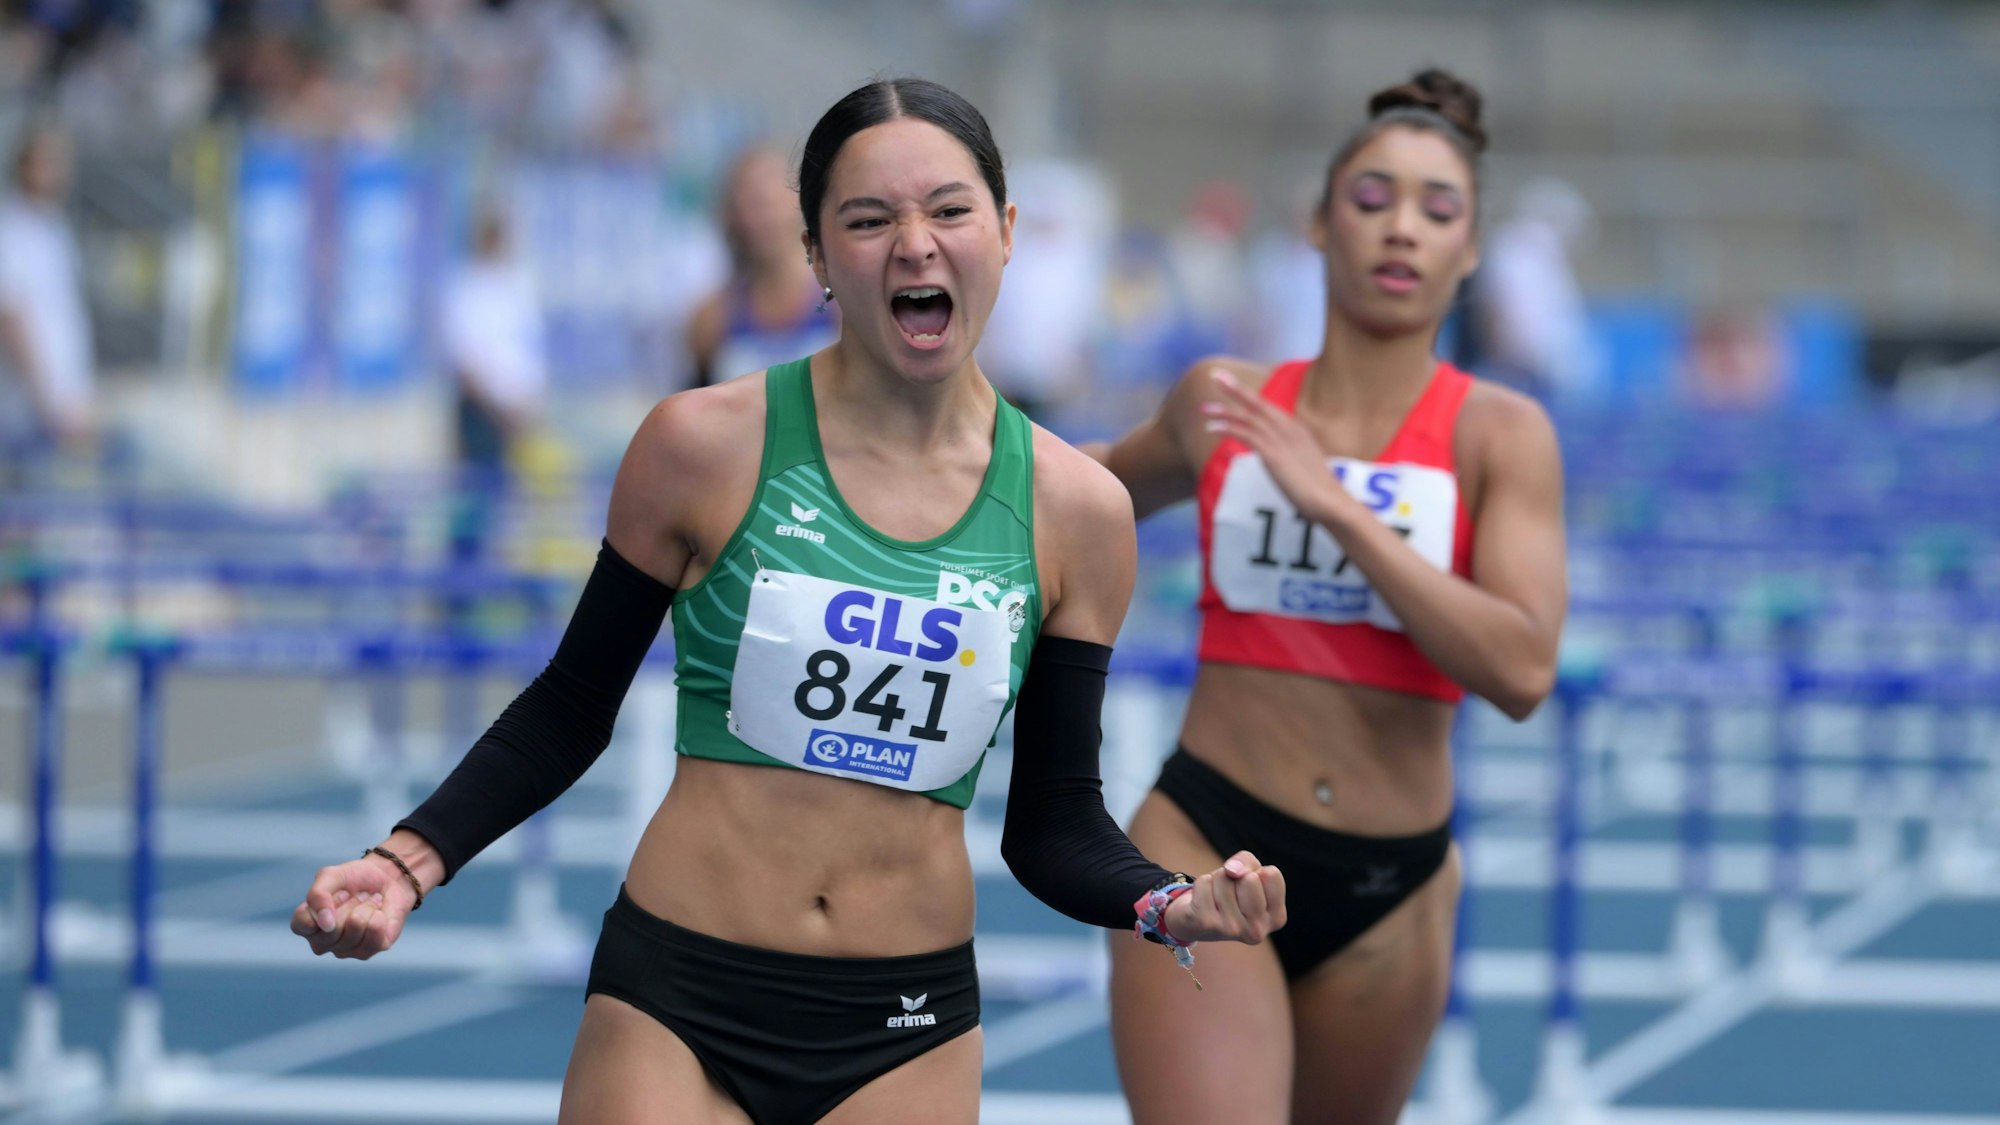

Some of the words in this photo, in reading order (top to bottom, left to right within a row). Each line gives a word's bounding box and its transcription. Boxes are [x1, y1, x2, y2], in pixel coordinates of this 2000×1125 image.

[775, 523, 826, 544] erima
[940, 560, 985, 577] PULHEIMER
[986, 572, 1009, 585] SPORT
[794, 649, 951, 742] 841
[850, 741, 912, 768] PLAN
[848, 760, 907, 777] INTERNATIONAL
[886, 1012, 937, 1028] erima
